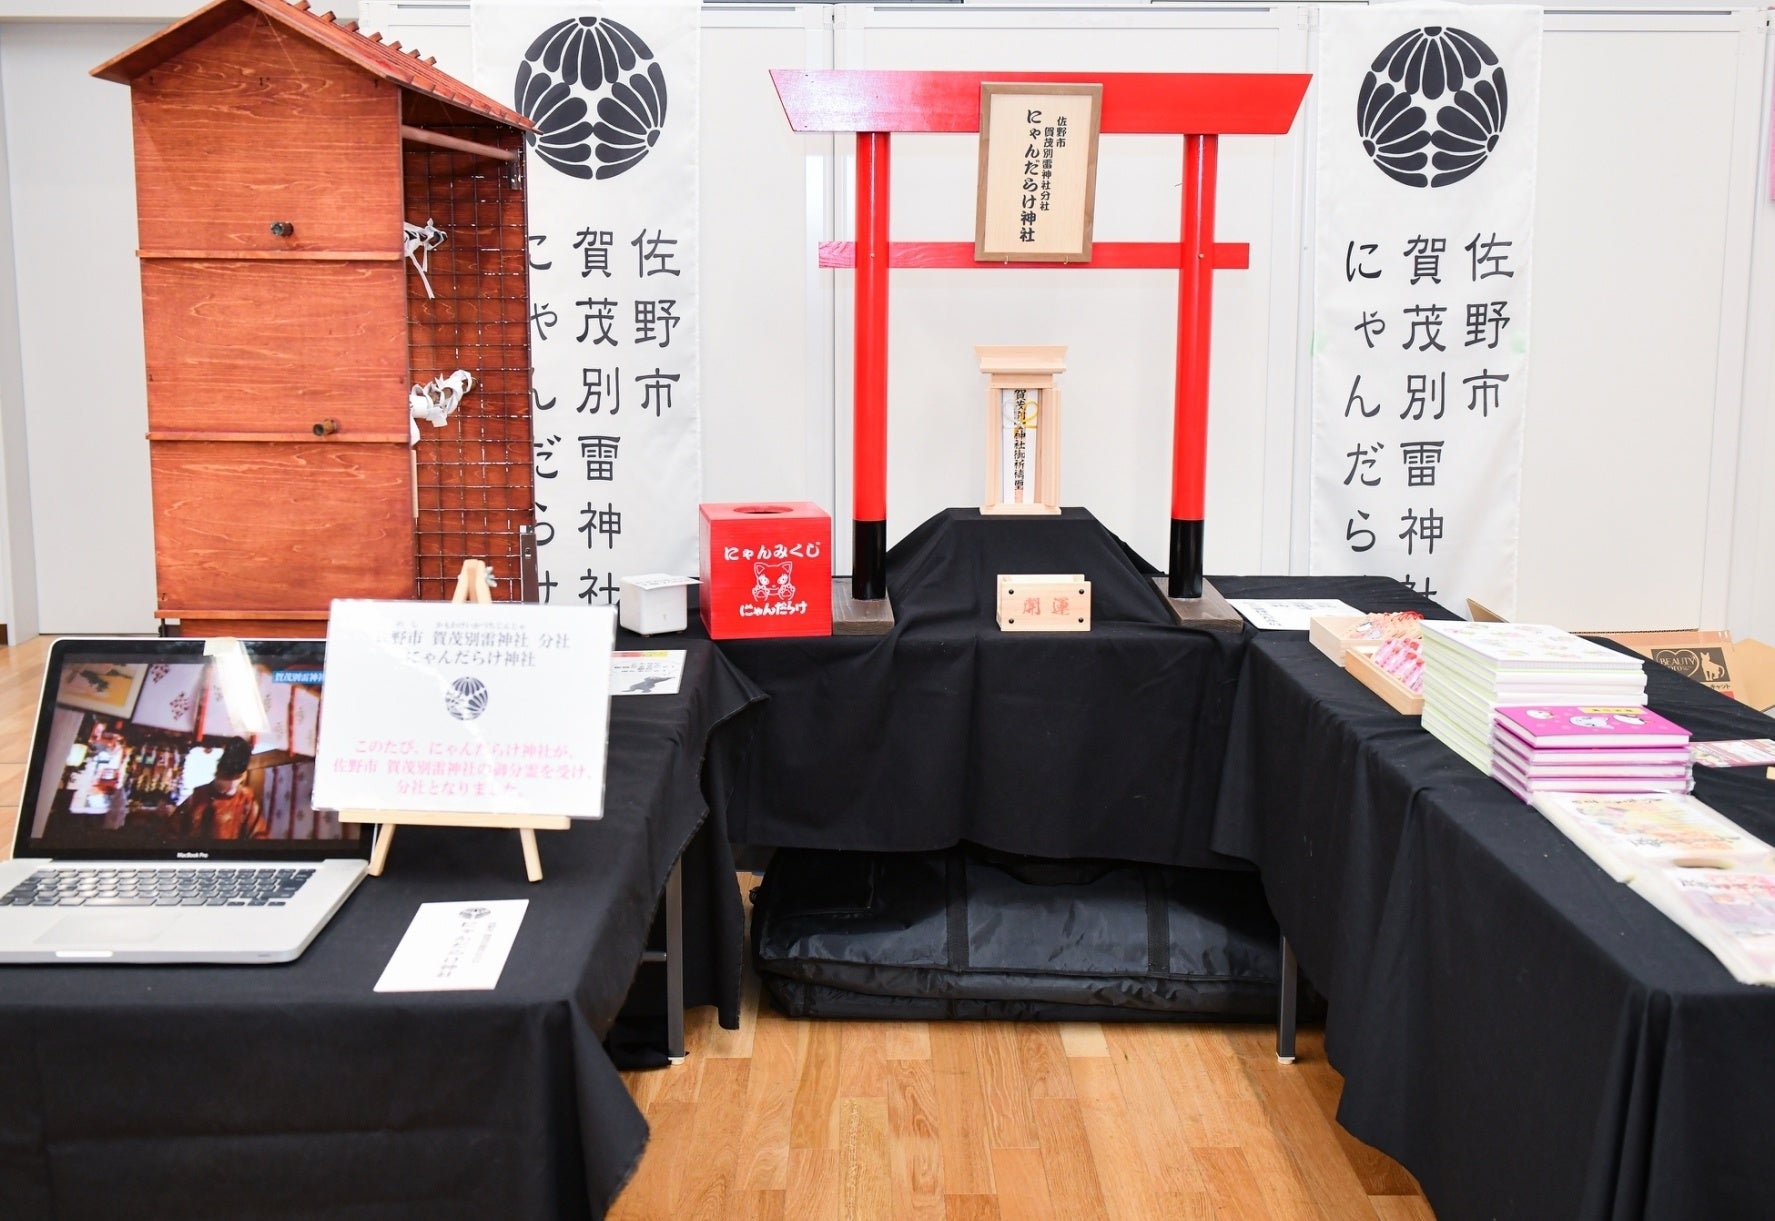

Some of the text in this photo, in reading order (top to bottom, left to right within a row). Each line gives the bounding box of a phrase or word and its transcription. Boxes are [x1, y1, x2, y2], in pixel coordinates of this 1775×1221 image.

[1055, 115, 1067, 148] 佐野市
[1019, 109, 1042, 243] にゃんだらけ神社
[1040, 126, 1054, 211] 賀茂別雷神社分社
[631, 228, 681, 417] 佐野市
[1462, 232, 1515, 418] 佐野市
[572, 226, 621, 605] 賀茂別雷神社
[724, 541, 821, 561] にゃんみくじ
[739, 601, 808, 617] にゃんだらけ
[378, 630, 571, 649] 野市 賀茂別雷神社 分社
[1659, 656, 1696, 666] BEAUTY
[333, 759, 378, 774] 佐野市
